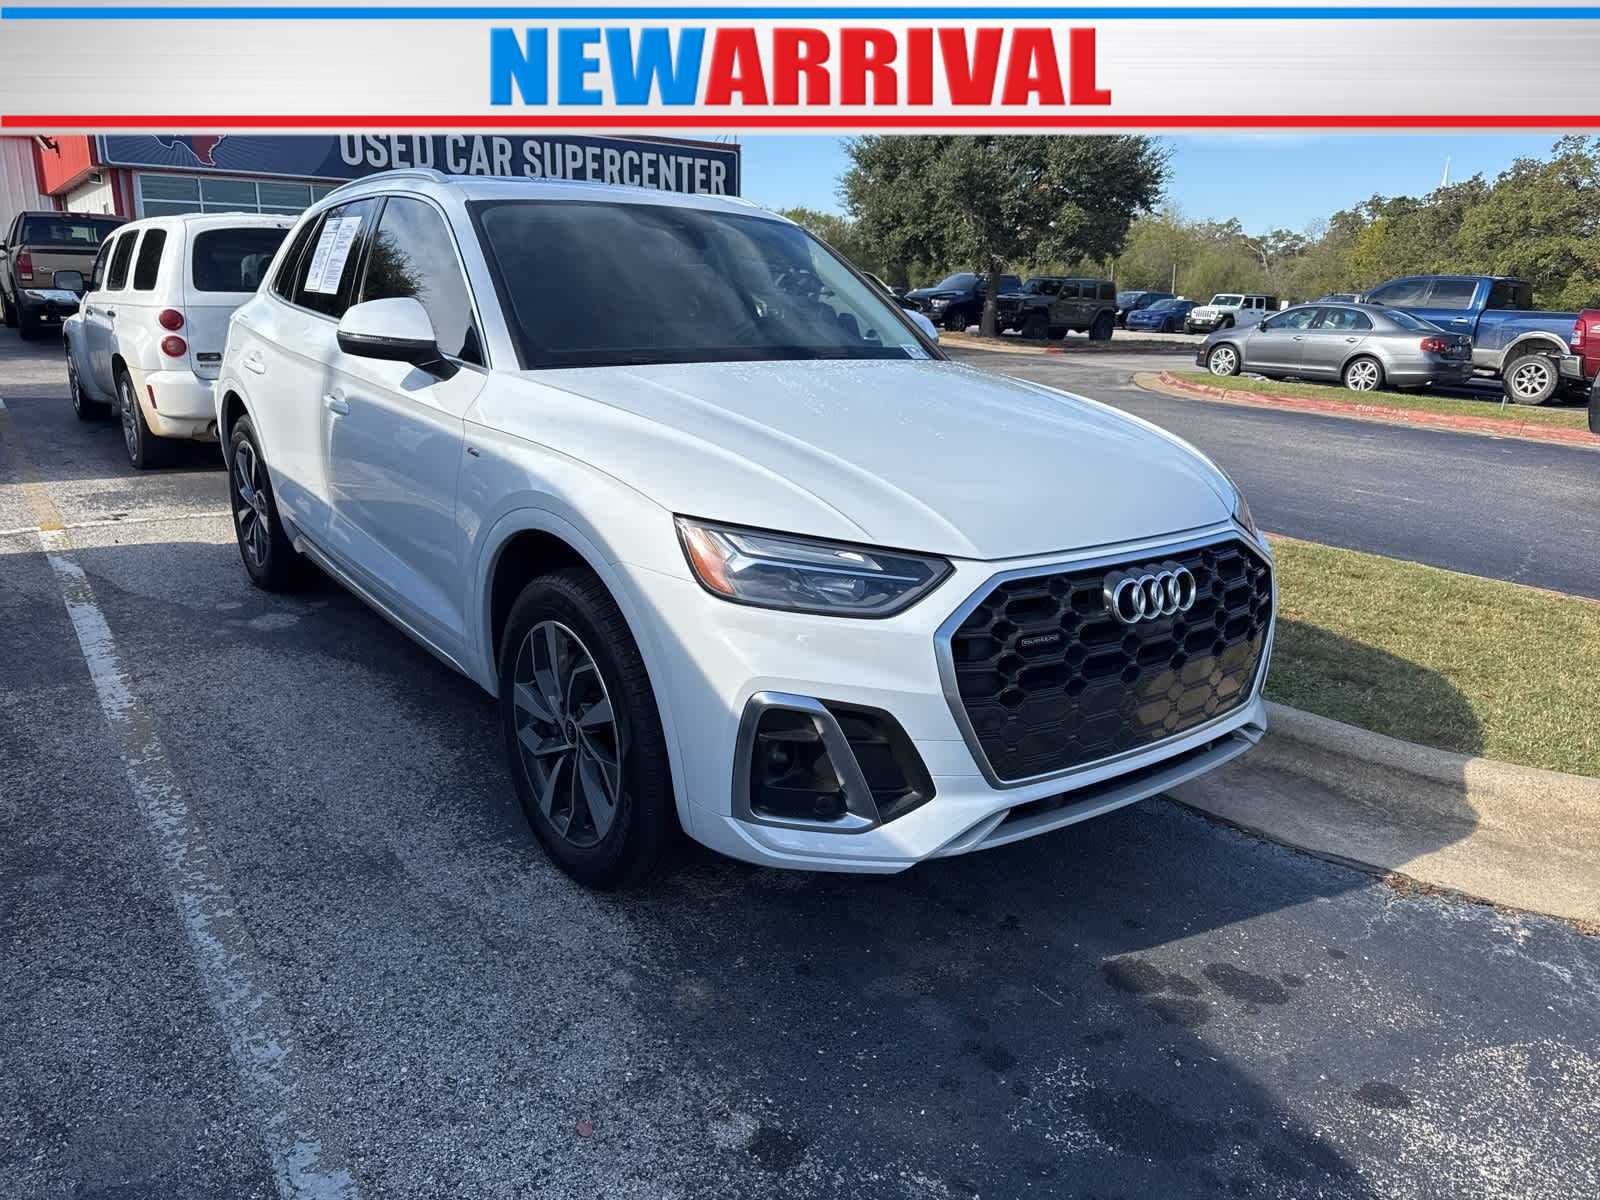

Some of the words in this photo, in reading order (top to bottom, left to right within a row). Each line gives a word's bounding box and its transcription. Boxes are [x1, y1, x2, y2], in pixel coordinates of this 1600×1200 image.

[339, 134, 435, 169] USED
[445, 134, 513, 176] CAR
[522, 140, 727, 196] SUPERCENTER
